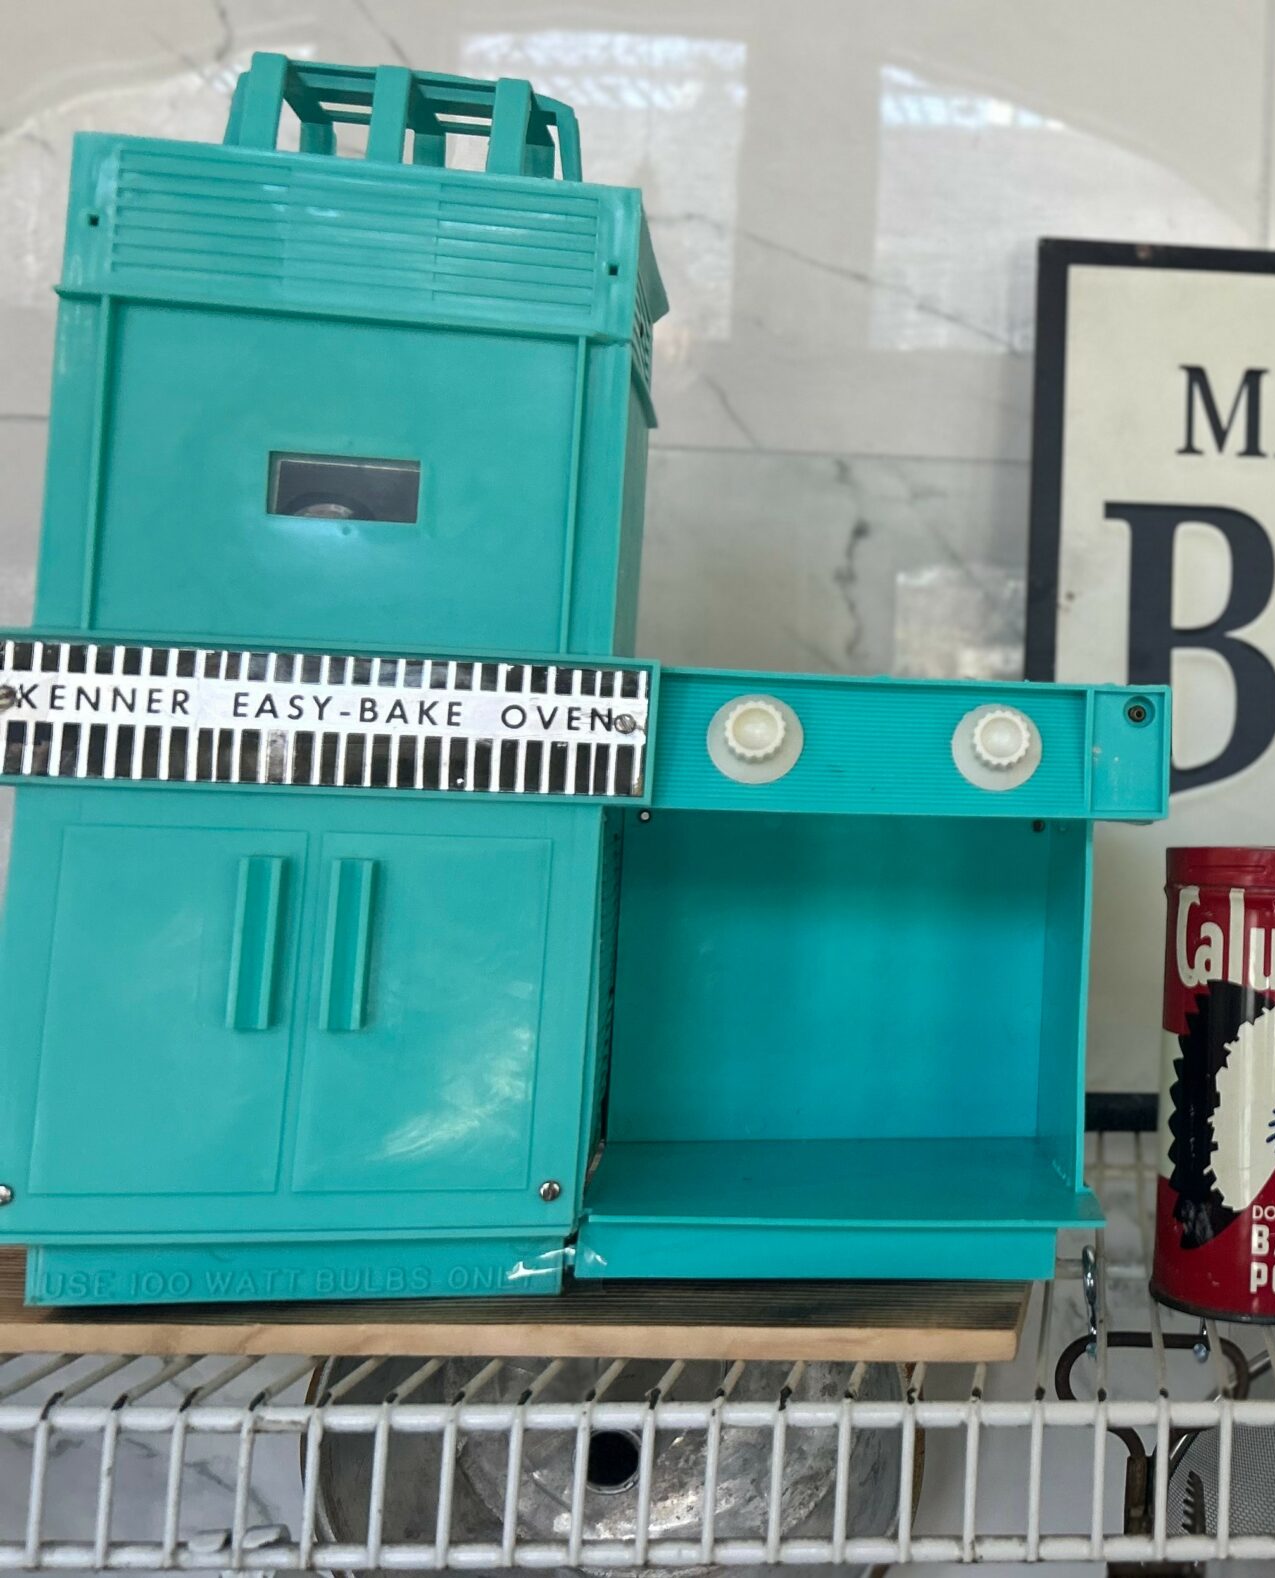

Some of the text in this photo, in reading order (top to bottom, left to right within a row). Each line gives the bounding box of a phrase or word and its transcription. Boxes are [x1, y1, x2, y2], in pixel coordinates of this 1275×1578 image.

[16, 683, 614, 733] KENNER EASY-BAKE OVEN
[43, 1272, 116, 1300] USE
[203, 1268, 303, 1295] WATT
[316, 1266, 430, 1293] BULBS
